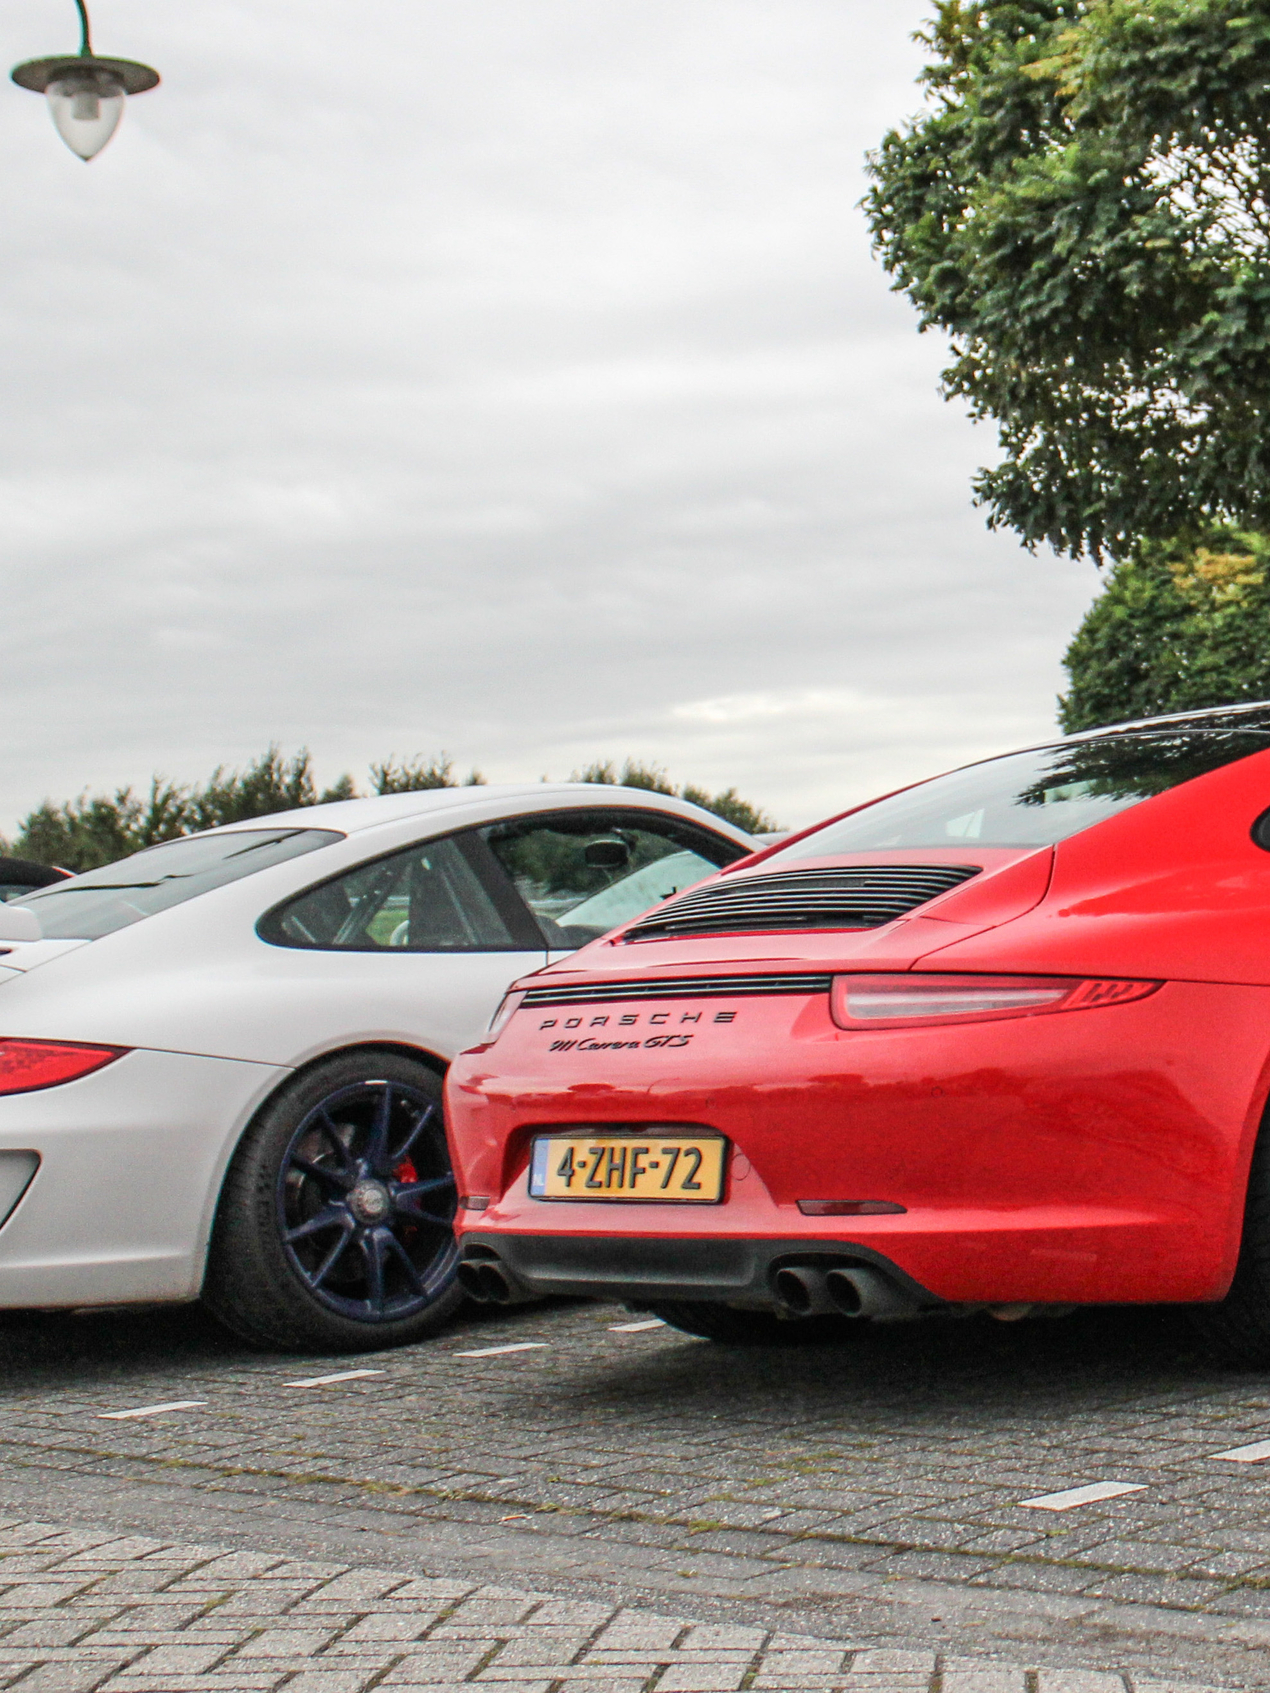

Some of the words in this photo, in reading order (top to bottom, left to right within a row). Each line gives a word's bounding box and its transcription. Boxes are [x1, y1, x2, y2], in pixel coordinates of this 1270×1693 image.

[539, 1011, 738, 1031] PORSCHE
[549, 1039, 577, 1051] 911
[577, 1037, 641, 1051] Carrera
[643, 1034, 695, 1049] GTS
[556, 1146, 703, 1190] 4-ZHF-72
